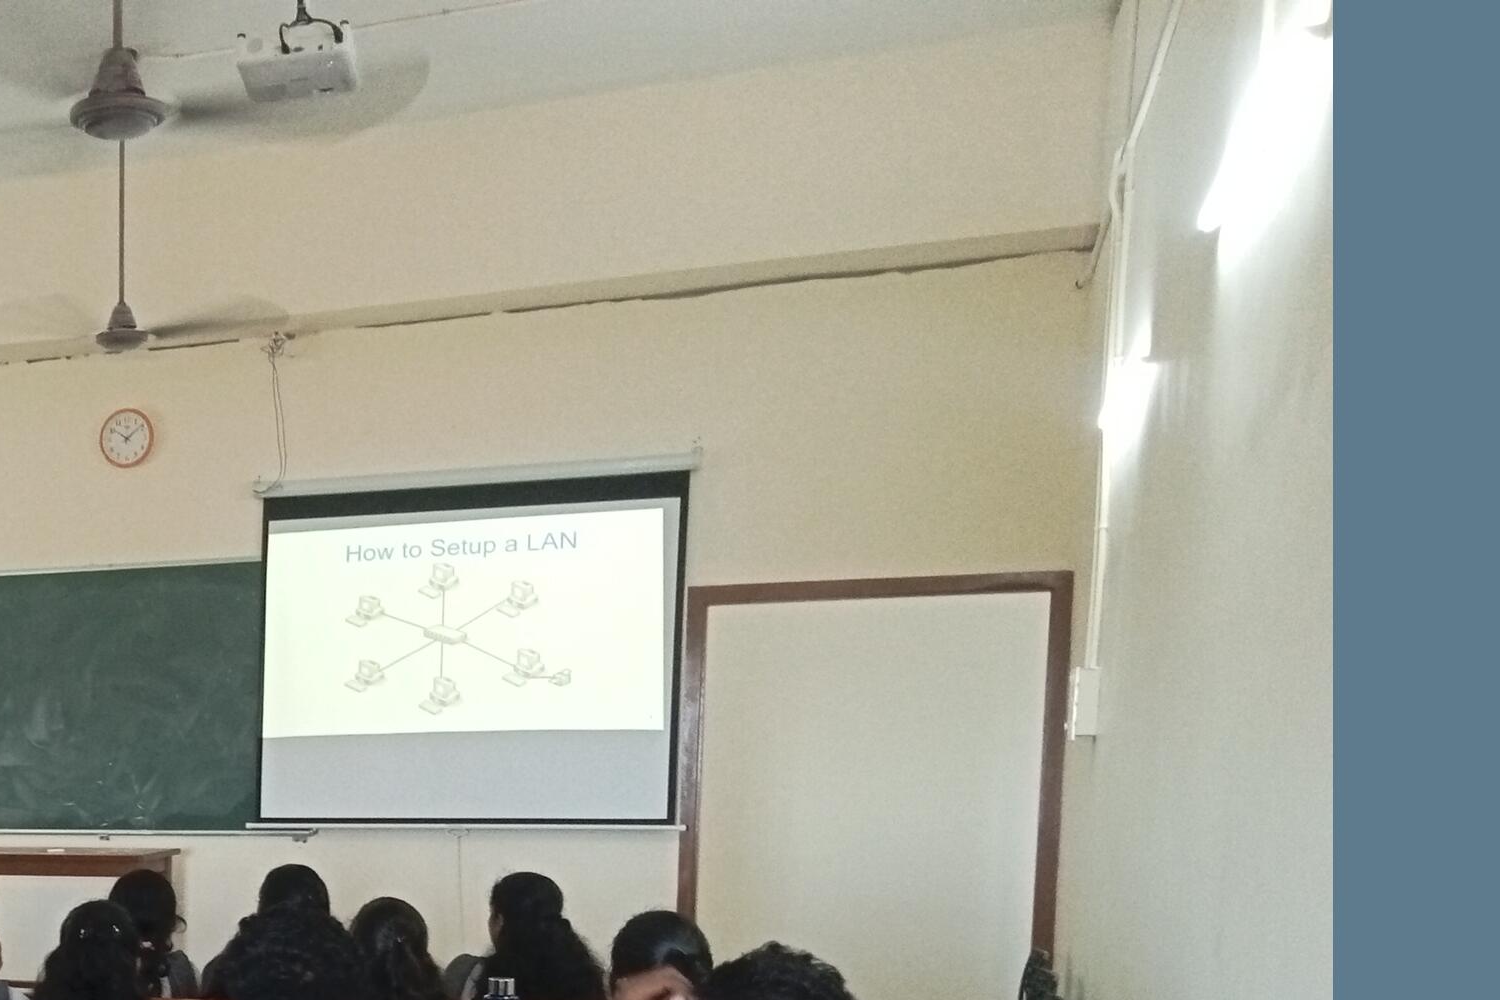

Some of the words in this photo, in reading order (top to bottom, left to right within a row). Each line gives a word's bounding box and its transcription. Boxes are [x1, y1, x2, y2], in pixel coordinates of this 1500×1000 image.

[346, 545, 394, 563] How
[402, 542, 422, 558] to
[430, 538, 497, 558] Setup
[505, 538, 518, 552] a
[527, 531, 578, 551] LAN
